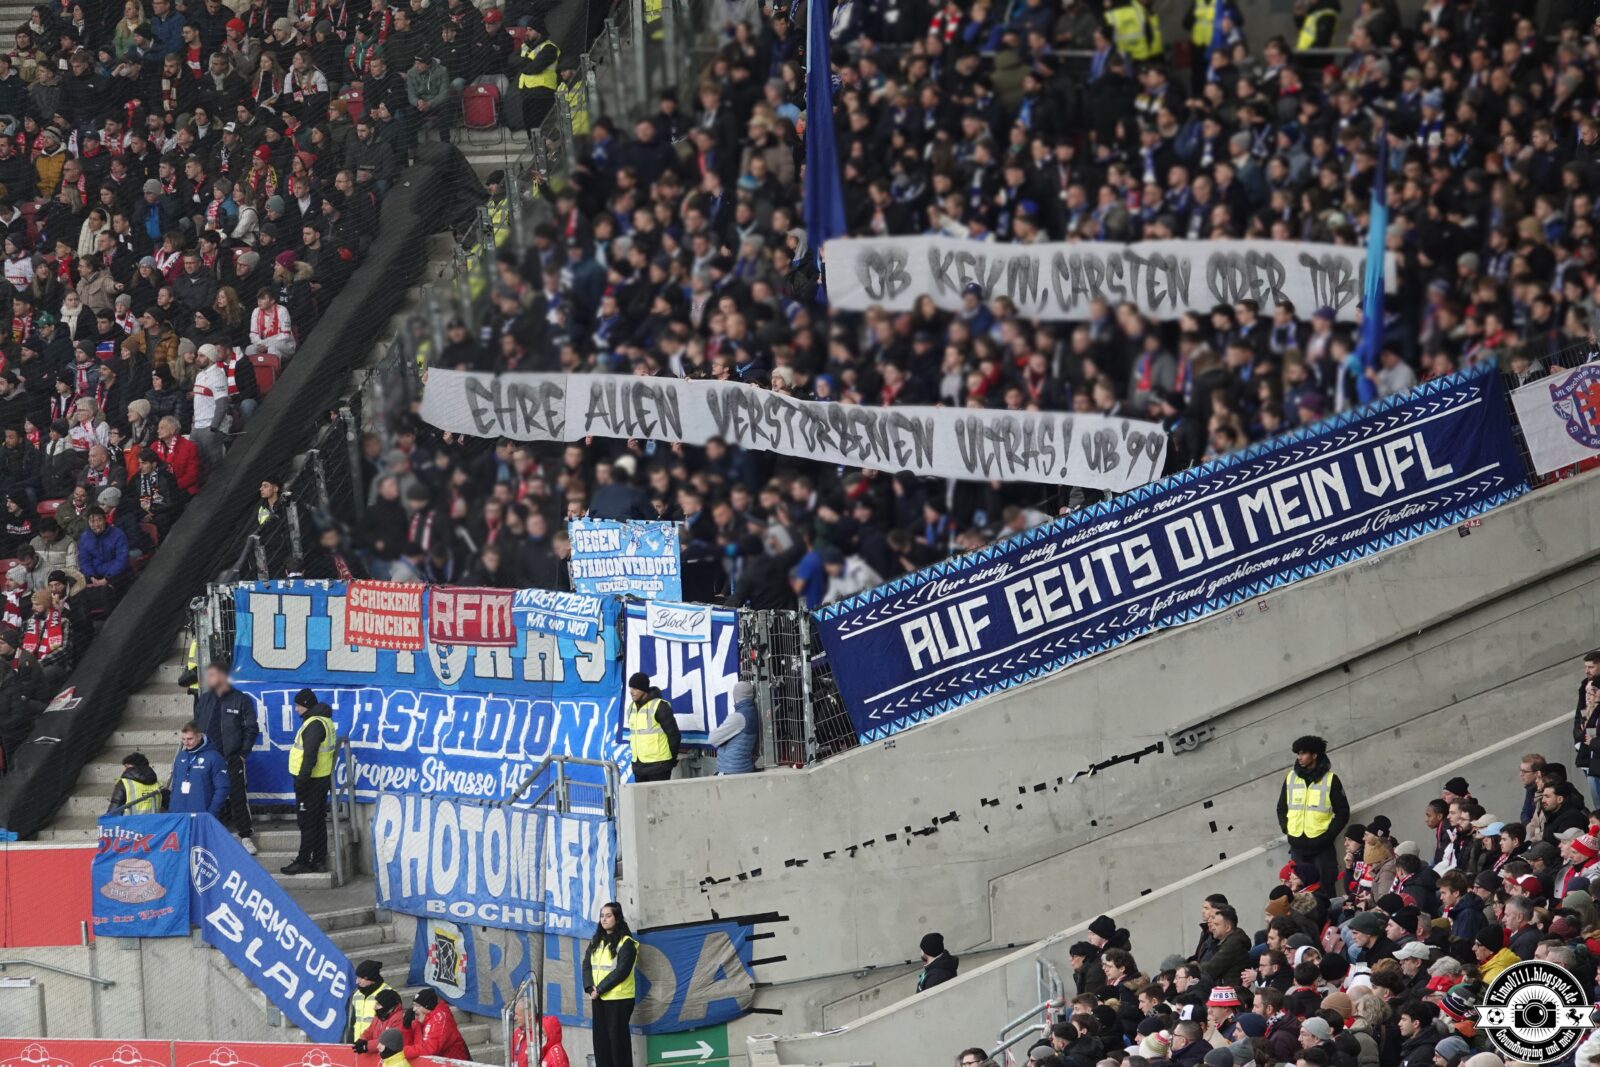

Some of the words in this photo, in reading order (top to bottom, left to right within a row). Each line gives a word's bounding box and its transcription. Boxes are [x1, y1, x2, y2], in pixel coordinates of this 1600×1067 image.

[857, 247, 912, 300] OB
[1052, 249, 1191, 313] CARSTEN
[1206, 249, 1290, 309] ODER
[1566, 369, 1590, 393] Bochum
[465, 376, 566, 439] EHRE
[585, 380, 682, 440] ALLEN
[706, 386, 935, 470] VERSTORBENEN
[955, 415, 1074, 479] ULTRAS!
[1081, 420, 1165, 482] UB'99
[575, 528, 621, 554] GEGEN
[900, 595, 991, 671] AUF
[1004, 533, 1163, 635] GEHTS
[1164, 504, 1235, 573] DU
[1237, 461, 1351, 543] MEIN
[1354, 431, 1453, 498] VFL
[917, 579, 966, 600] Nur
[1019, 541, 1058, 563] einig
[1062, 519, 1121, 547] müssen
[1123, 507, 1151, 526] wir
[571, 556, 677, 579] STADIONVERBOTE
[1122, 603, 1150, 627] So
[1148, 590, 1178, 621] fest
[1176, 578, 1206, 603] und
[1206, 560, 1281, 598] geschlossen
[1281, 547, 1305, 563] wie
[1307, 533, 1339, 556] Erz
[1341, 518, 1372, 544] und
[1371, 502, 1428, 532] Gestein
[350, 586, 420, 614] SCHICKERIA
[512, 587, 602, 617] DURCHZIEHEN
[652, 608, 688, 632] Block
[349, 610, 421, 638] MÜNCHEN
[420, 756, 498, 797] Strasse
[374, 793, 612, 923] PHOTOMAFIA
[426, 898, 573, 928] BOCHUM
[222, 869, 347, 999] ALARMSTUFE
[205, 902, 337, 1030] BLAU
